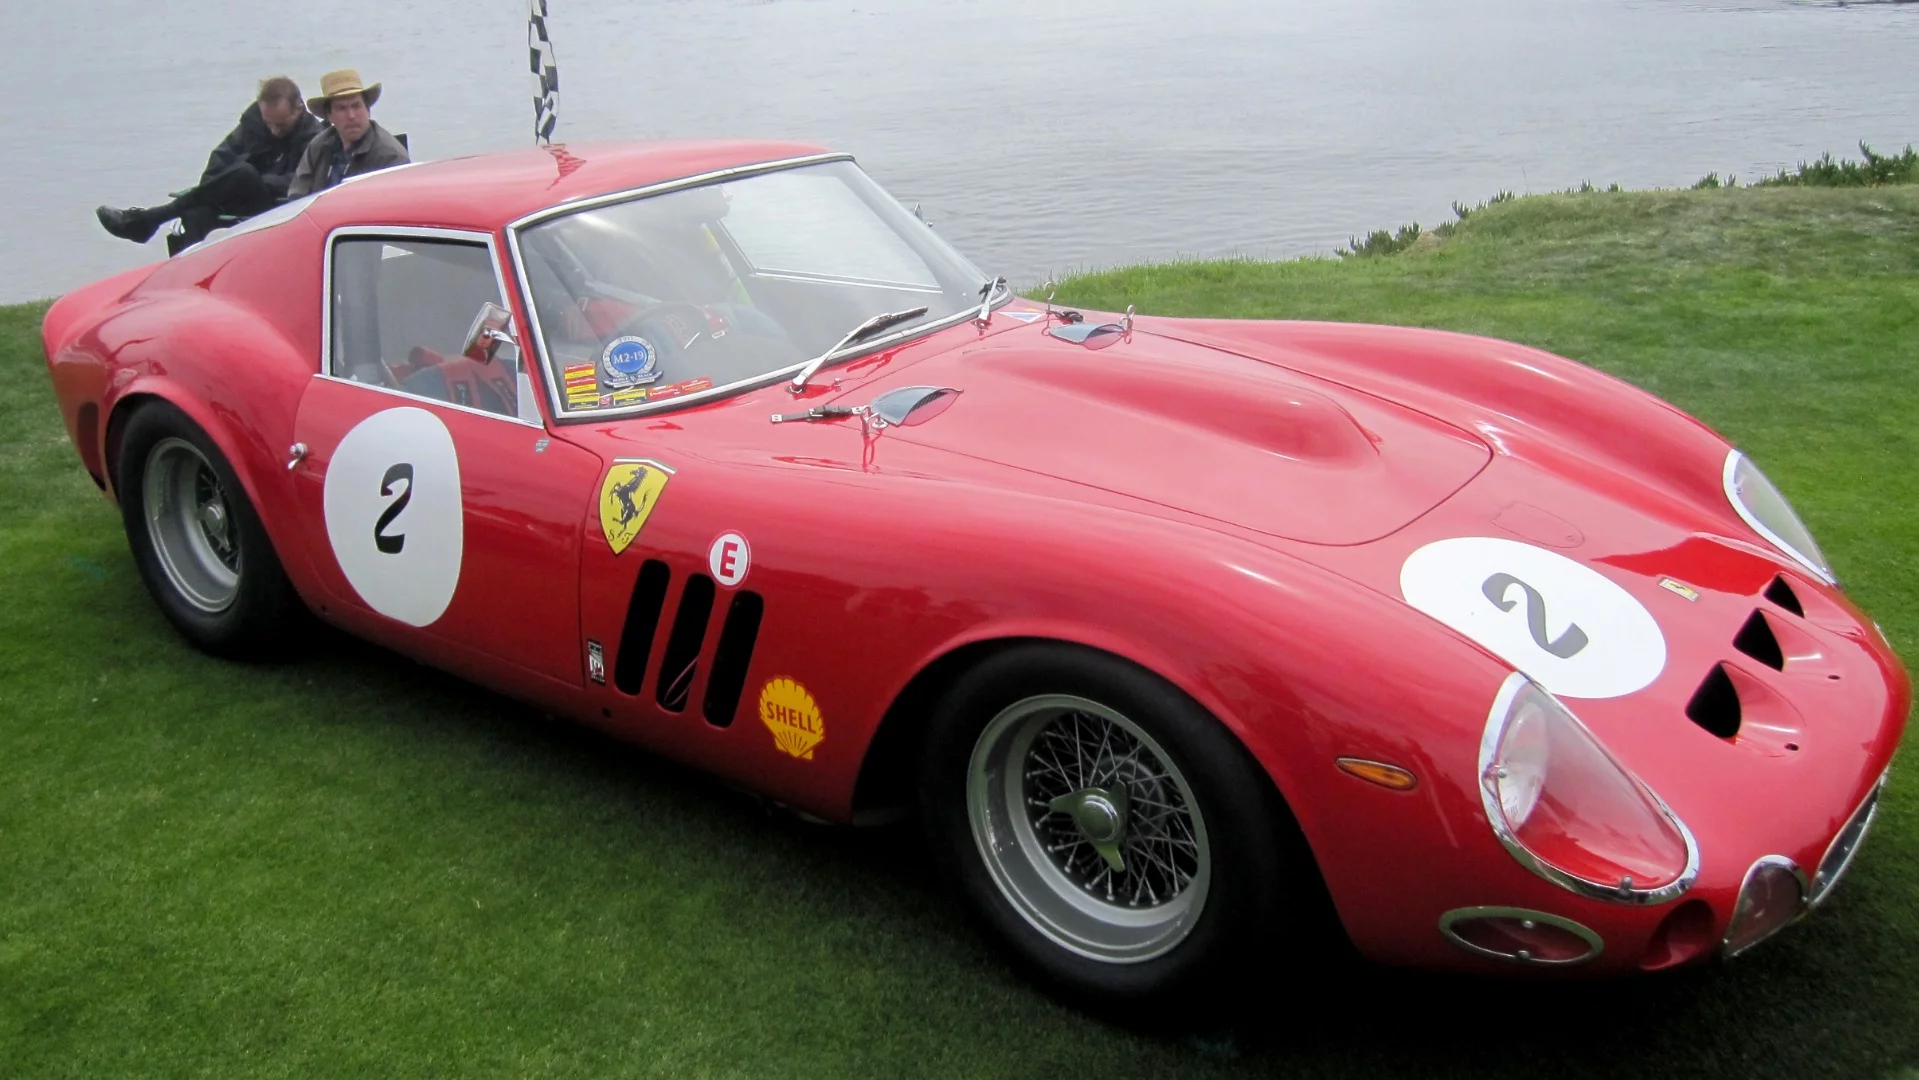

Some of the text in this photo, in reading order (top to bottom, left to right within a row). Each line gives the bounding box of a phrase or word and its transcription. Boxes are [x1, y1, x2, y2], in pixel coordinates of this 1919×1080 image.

[613, 350, 644, 364] M2-19
[374, 462, 414, 555] 2
[719, 541, 739, 579] E
[1481, 571, 1589, 660] 2
[766, 699, 817, 734] SHELL
